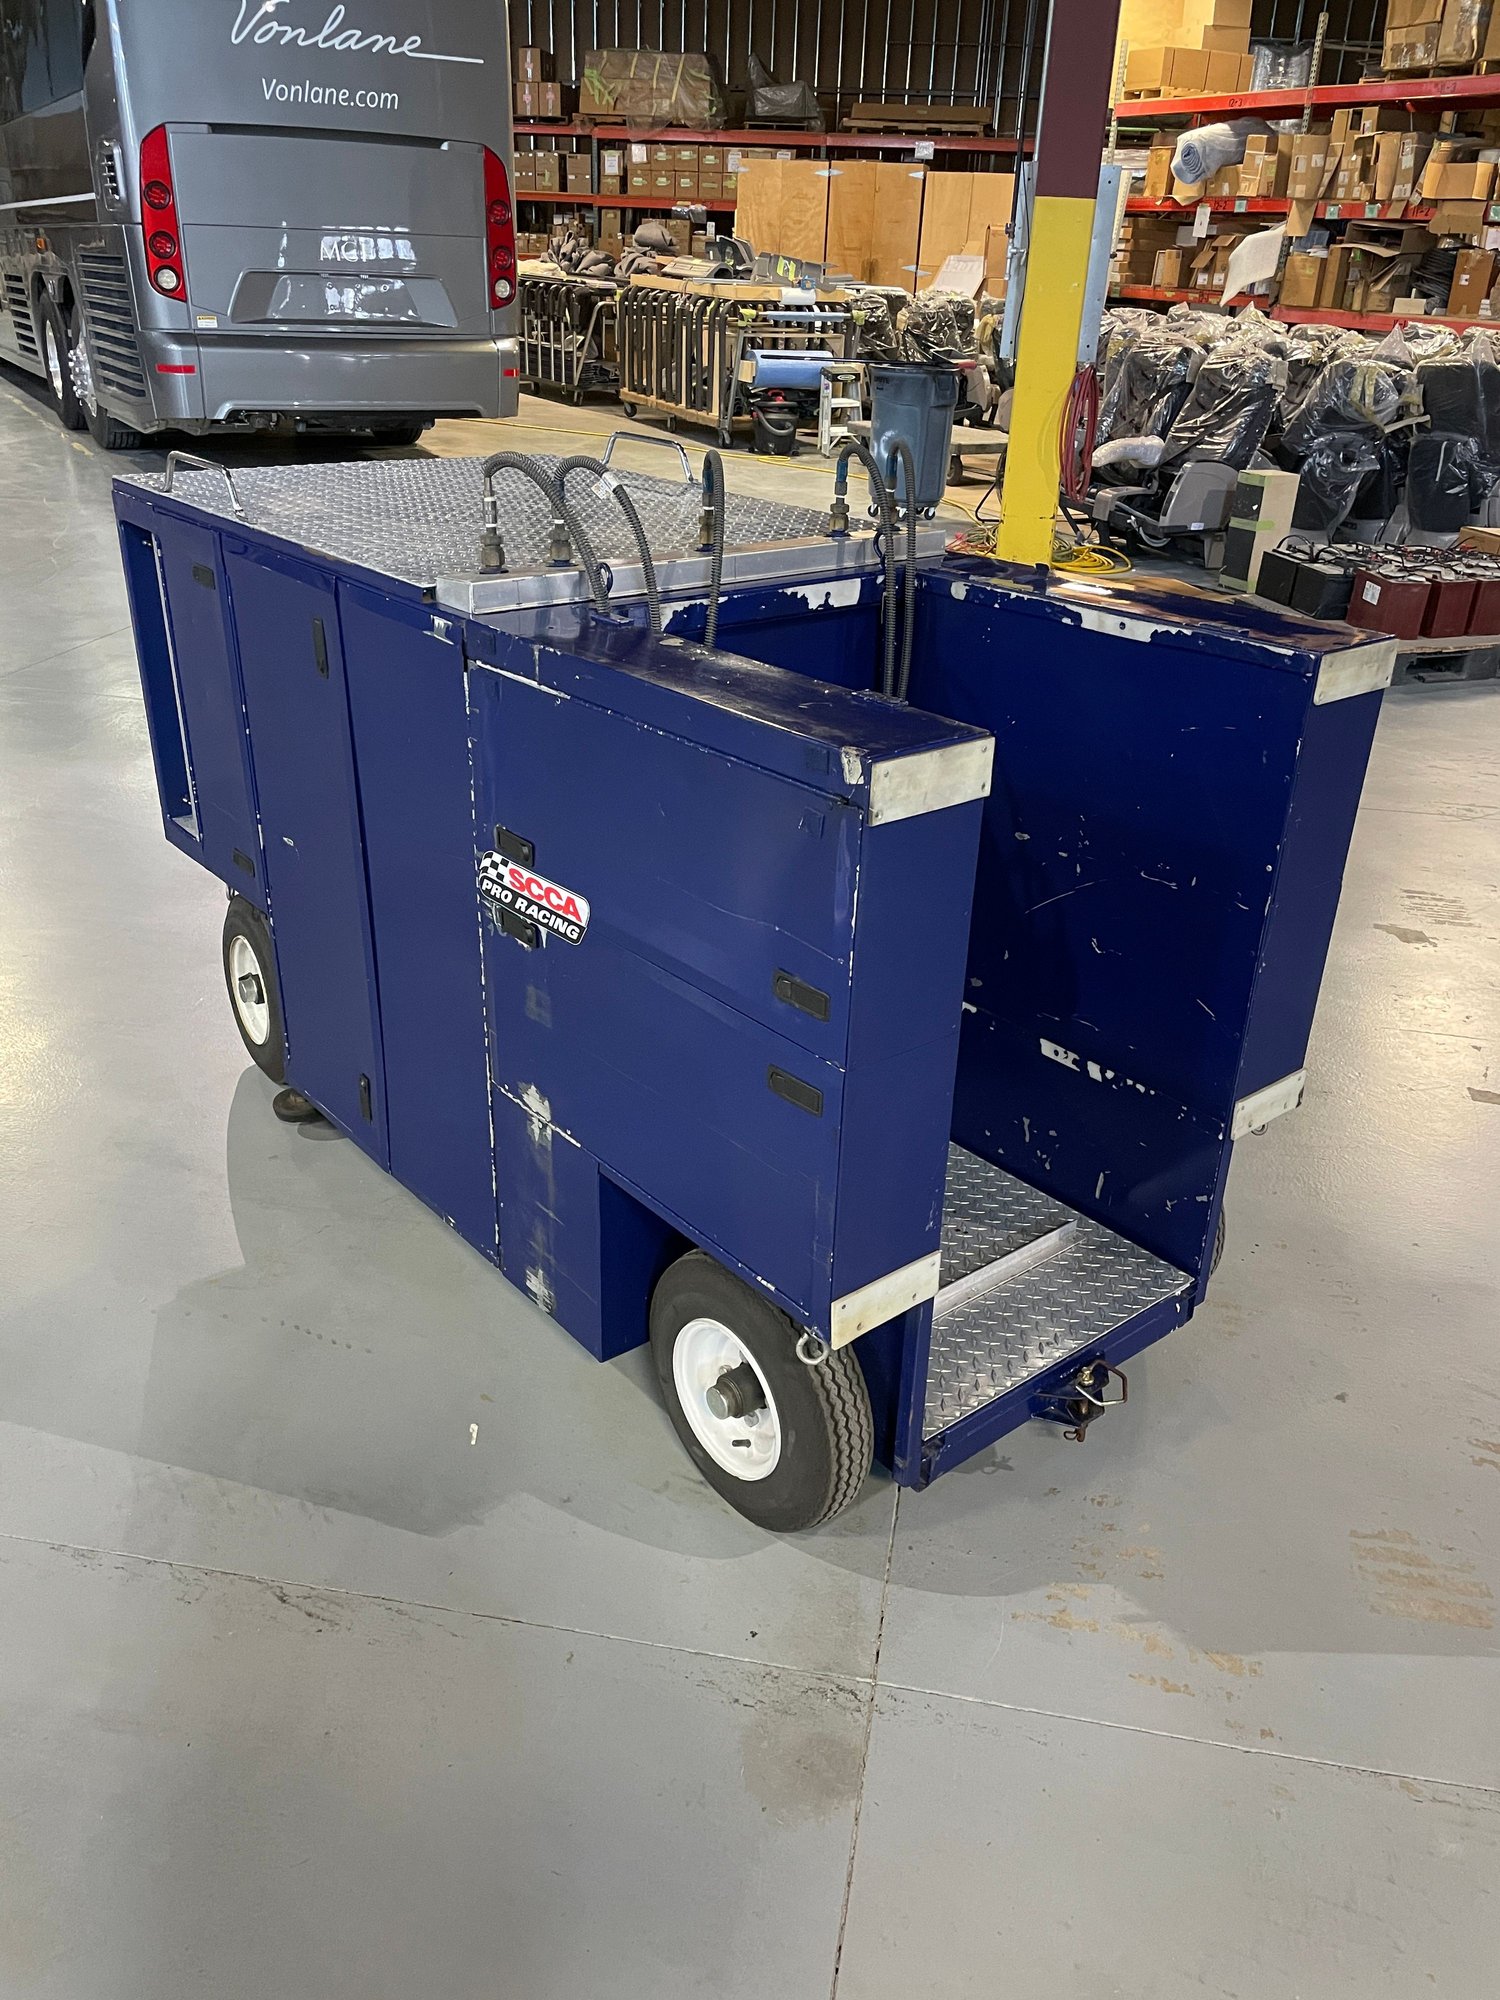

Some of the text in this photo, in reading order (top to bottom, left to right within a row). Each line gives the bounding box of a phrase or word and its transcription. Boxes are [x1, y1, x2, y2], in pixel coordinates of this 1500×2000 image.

[231, 0, 484, 64] Vonlane
[261, 78, 399, 110] Vonlane.com
[319, 239, 367, 262] MCI
[481, 878, 580, 940] PRO RACING
[508, 867, 582, 923] SCCA
